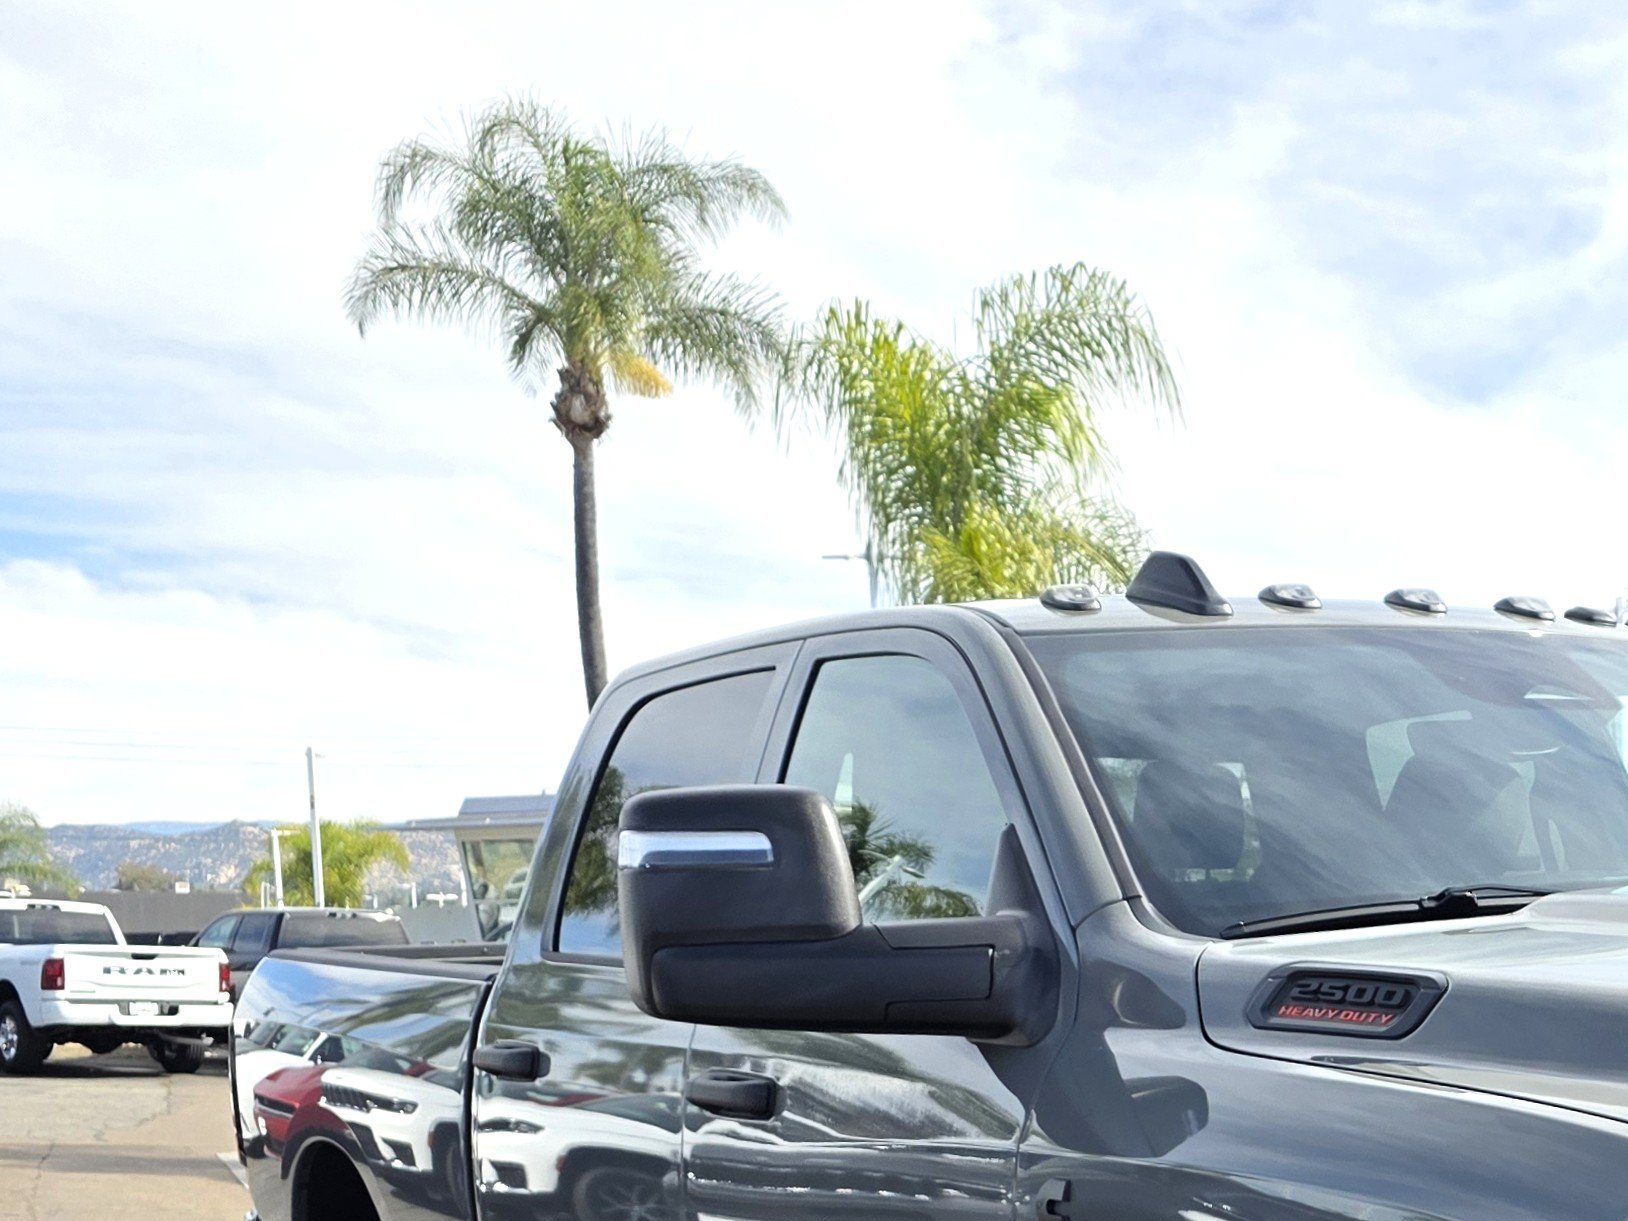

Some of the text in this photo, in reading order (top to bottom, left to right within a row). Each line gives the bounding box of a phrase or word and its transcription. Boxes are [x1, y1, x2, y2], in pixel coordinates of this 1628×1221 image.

[103, 966, 186, 976] RAM
[1290, 979, 1407, 1006] 2500
[1278, 1005, 1394, 1024] HEAVY DUTY
